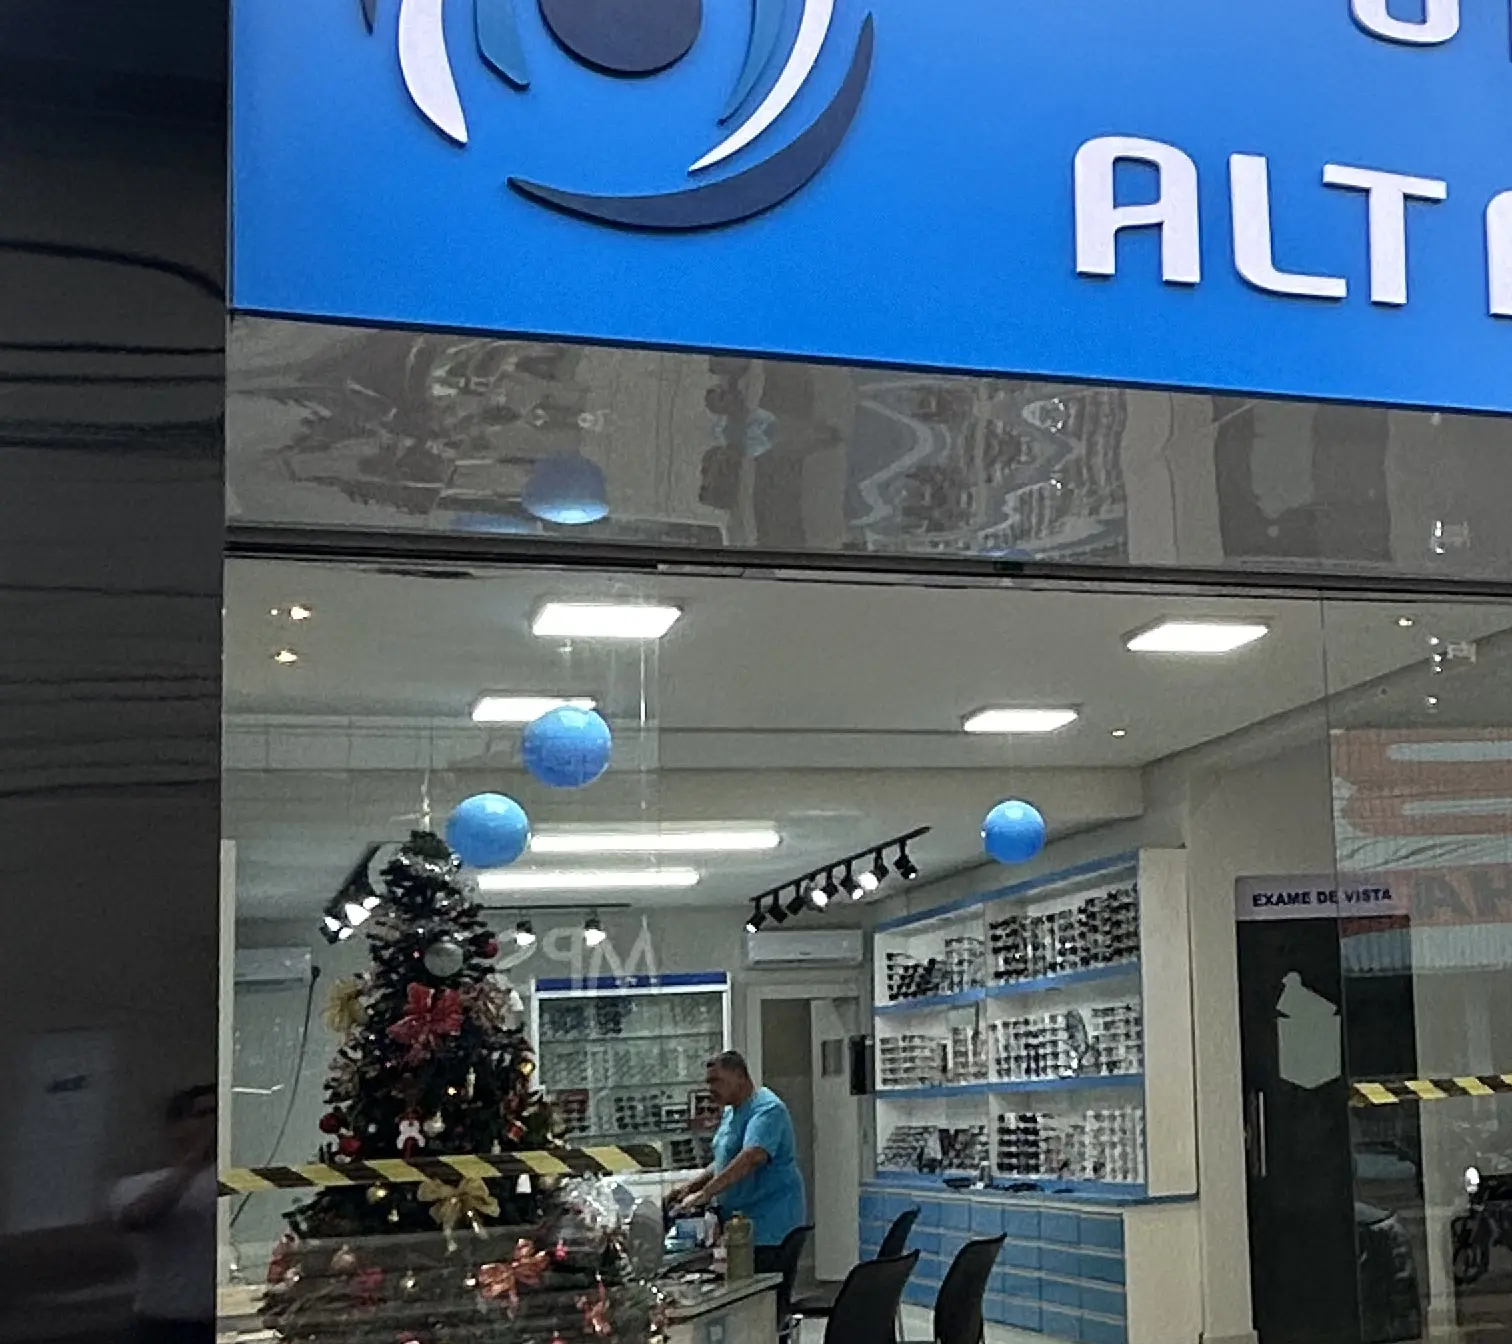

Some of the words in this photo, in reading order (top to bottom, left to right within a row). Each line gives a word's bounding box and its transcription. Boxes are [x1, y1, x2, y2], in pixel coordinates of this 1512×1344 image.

[1252, 891, 1312, 907] EXAME
[1316, 890, 1338, 905] DE
[1344, 887, 1393, 904] VISTA
